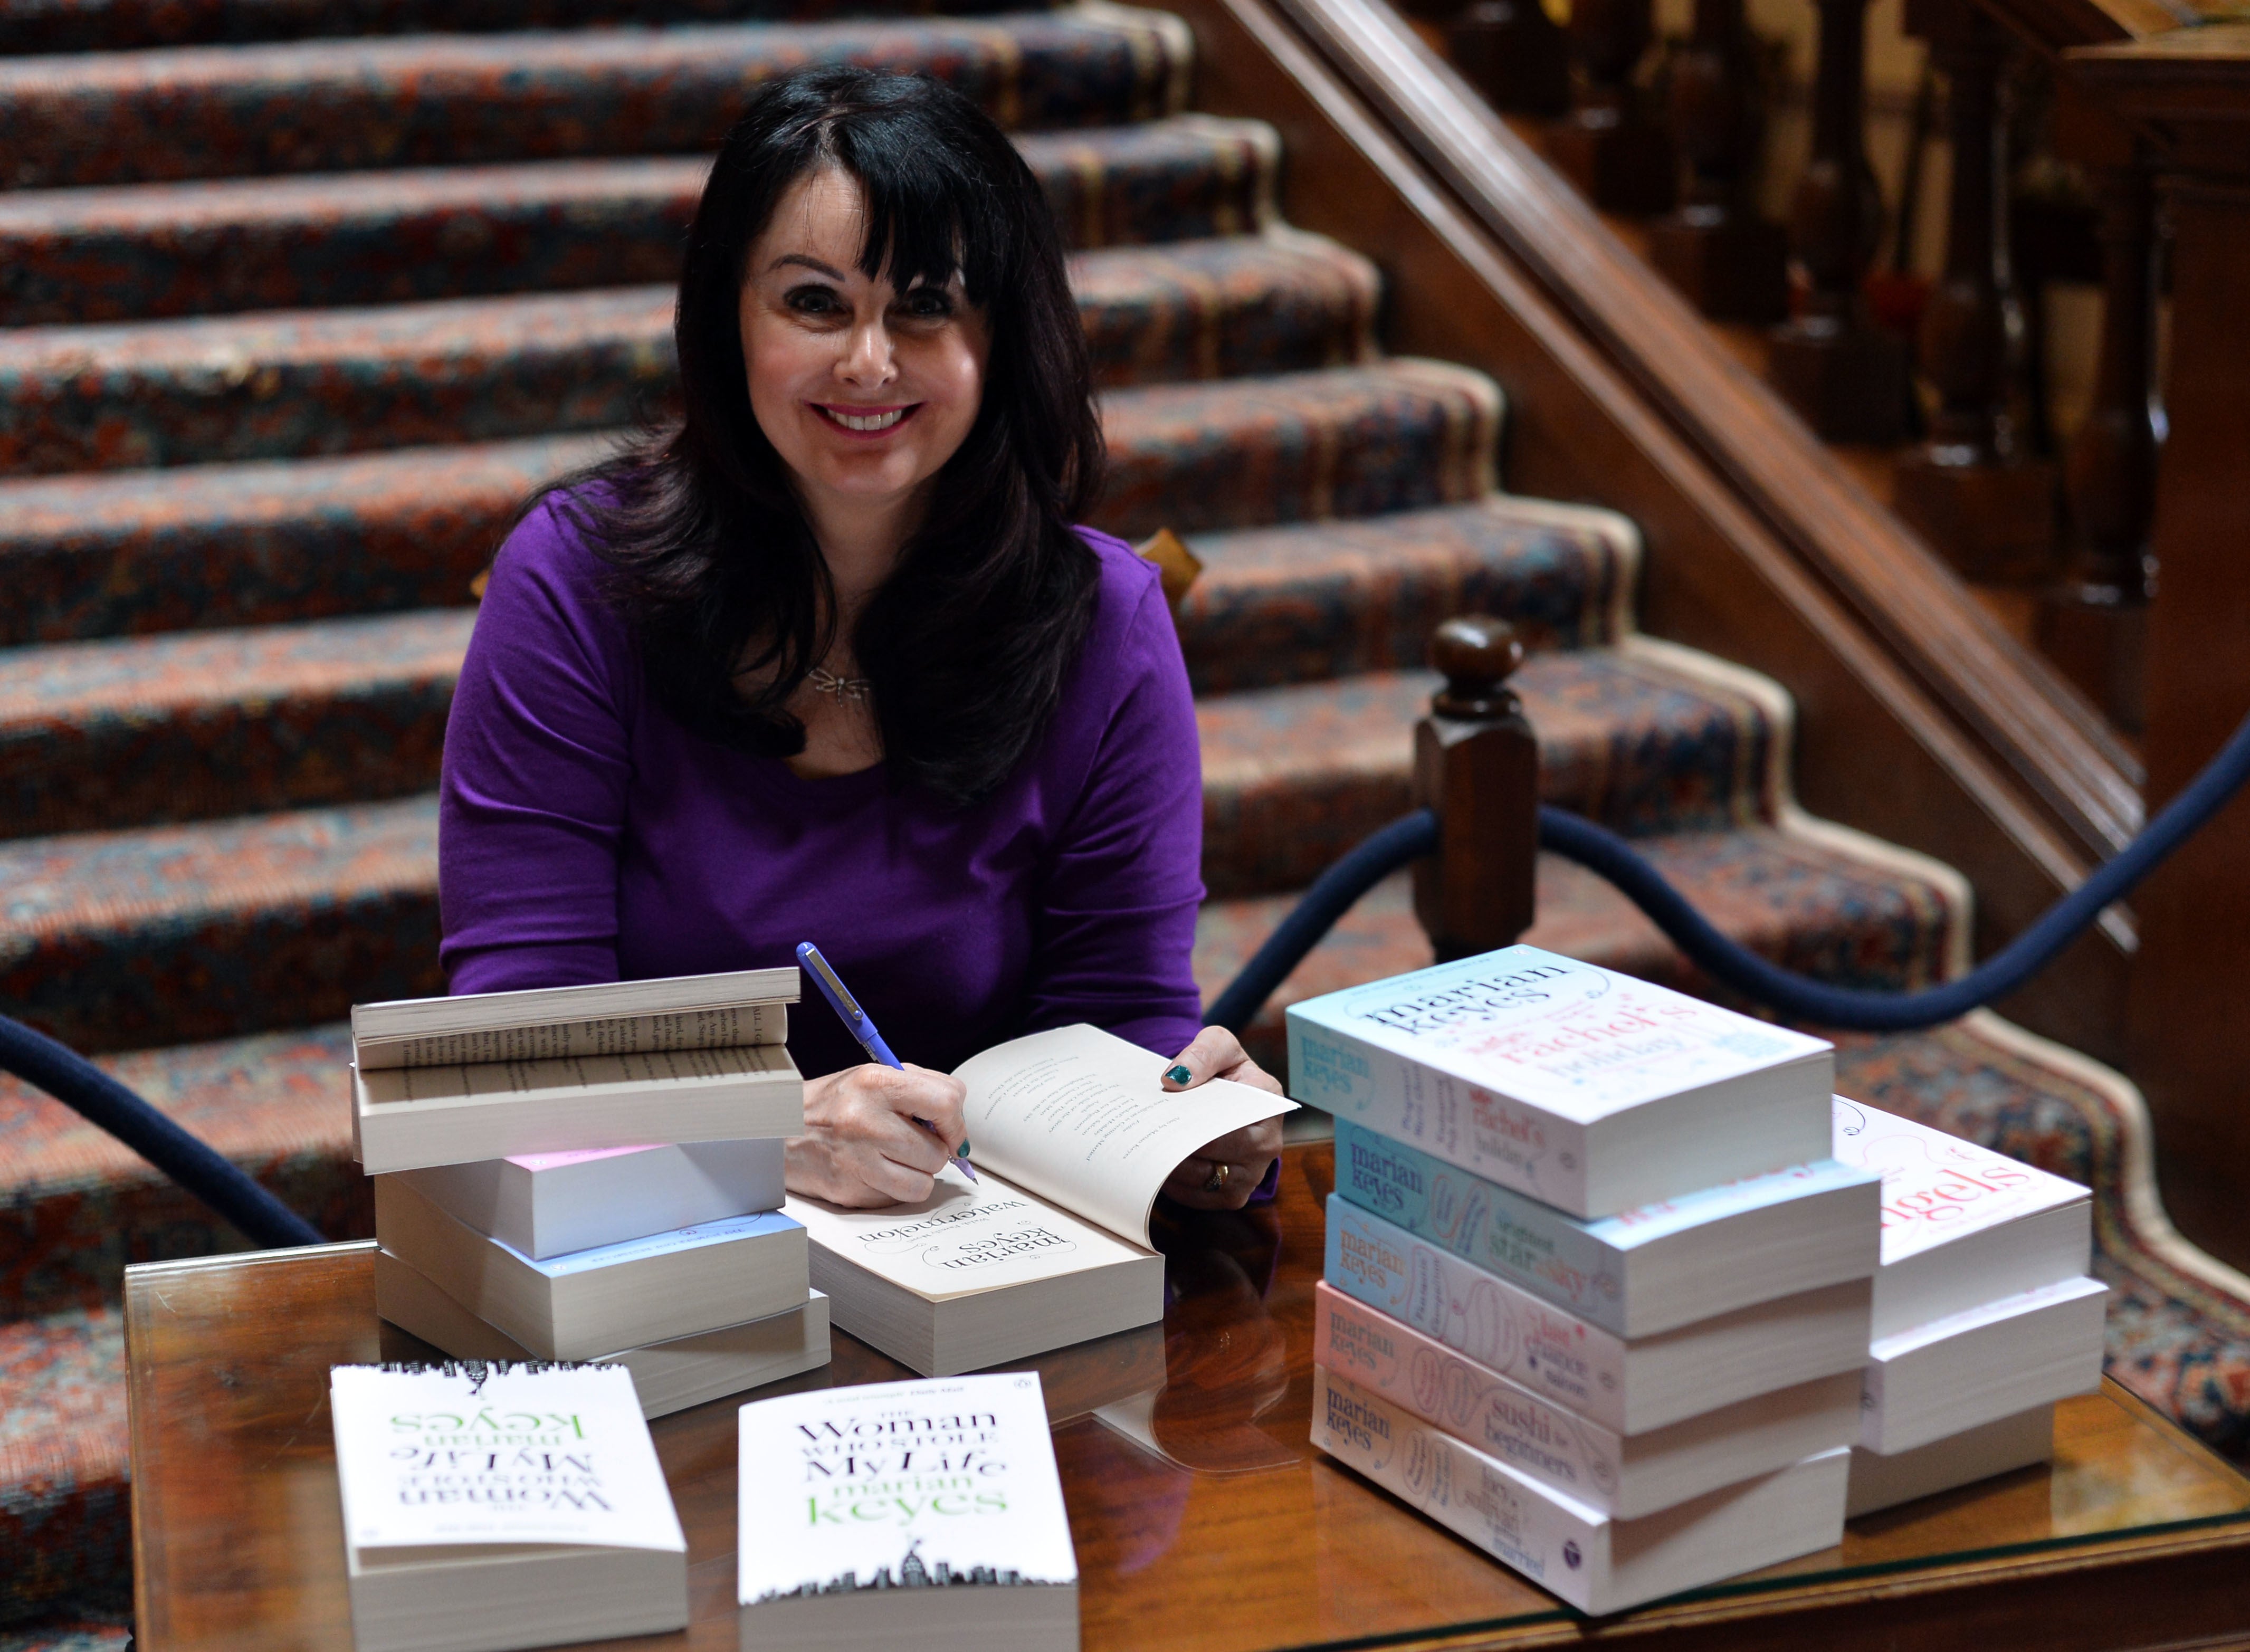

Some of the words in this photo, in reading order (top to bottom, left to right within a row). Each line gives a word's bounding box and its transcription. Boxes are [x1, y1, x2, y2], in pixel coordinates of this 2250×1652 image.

[1365, 963, 1574, 1025] marian
[1390, 989, 1550, 1036] keyes
[1301, 1036, 1370, 1078] marian
[1302, 1061, 1352, 1094] keyes
[1086, 1139, 1104, 1161] Married
[1123, 1144, 1139, 1159] Keyes
[1139, 1130, 1158, 1143] Marian
[1351, 1143, 1423, 1195] marian
[1351, 1167, 1404, 1211] keyes
[1881, 1167, 2029, 1229] ngels
[856, 1200, 1028, 1242] watermelon
[939, 1235, 1070, 1269] marian
[959, 1226, 1057, 1253] keyes
[1340, 1229, 1405, 1275] marian
[1340, 1253, 1387, 1289] keyes
[1330, 1312, 1394, 1359] marian
[1330, 1334, 1377, 1370] keyes
[389, 1407, 587, 1440] keyes
[795, 1412, 998, 1441] Woman
[1327, 1387, 1390, 1441] marian
[1327, 1409, 1372, 1452] keyes
[1492, 1399, 1551, 1445] sushi
[389, 1446, 498, 1471] Life
[423, 1432, 561, 1450] marian
[802, 1441, 882, 1457] WHO
[890, 1433, 999, 1448] STOLE
[1484, 1412, 1578, 1483] beginners
[512, 1448, 594, 1473] My
[806, 1456, 888, 1483] My
[901, 1449, 1007, 1477] Life
[399, 1488, 616, 1512] Woman
[834, 1475, 974, 1498] marian
[809, 1491, 1008, 1526] keyes
